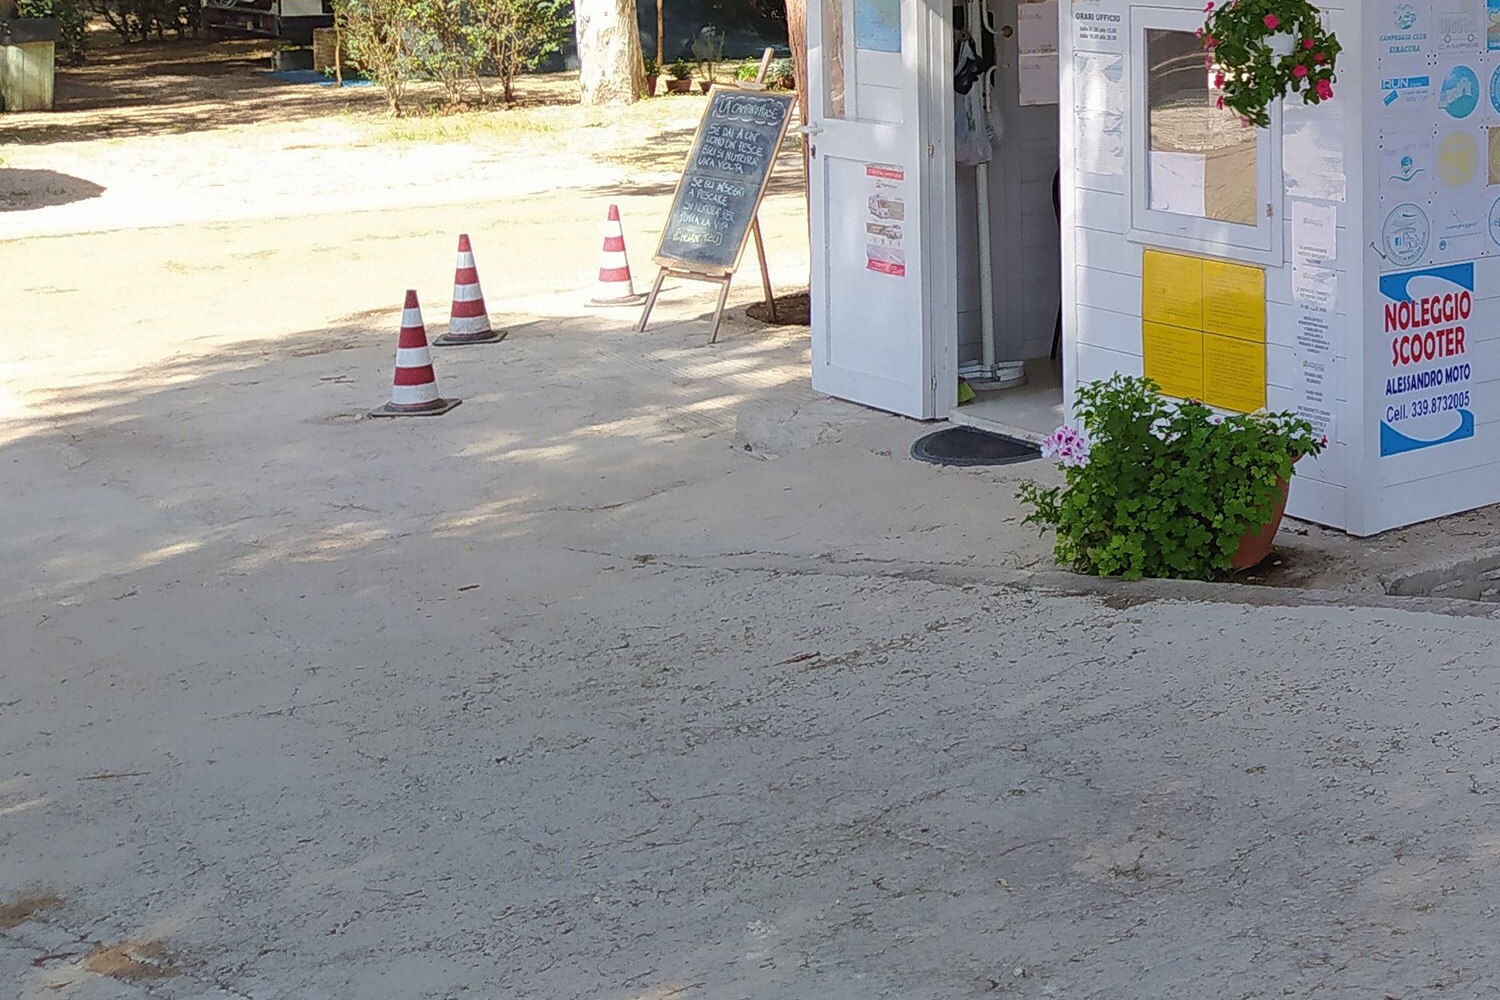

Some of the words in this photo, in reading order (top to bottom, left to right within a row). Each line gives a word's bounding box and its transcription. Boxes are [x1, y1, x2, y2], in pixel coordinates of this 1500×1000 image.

[1075, 12, 1095, 21] ORARI
[1095, 13, 1121, 23] UFFICIO
[1412, 33, 1427, 41] CLUB
[1389, 45, 1421, 54] SIRACUSA
[1381, 78, 1409, 90] RUN
[708, 123, 721, 136] SE
[721, 127, 735, 138] DAI
[736, 128, 744, 139] A
[744, 131, 761, 142] UN
[738, 142, 764, 157] PESCE
[717, 160, 744, 174] VOLTA
[691, 176, 703, 188] SE
[696, 188, 728, 207] PESCARE
[1385, 290, 1471, 333] NOLEGGIO
[1392, 326, 1466, 367] SCOOTER
[1385, 367, 1444, 397] ALESSANDRO
[1444, 362, 1471, 384] MOTO
[1386, 402, 1409, 424] Cell.
[1411, 390, 1470, 418] 339.8732005
